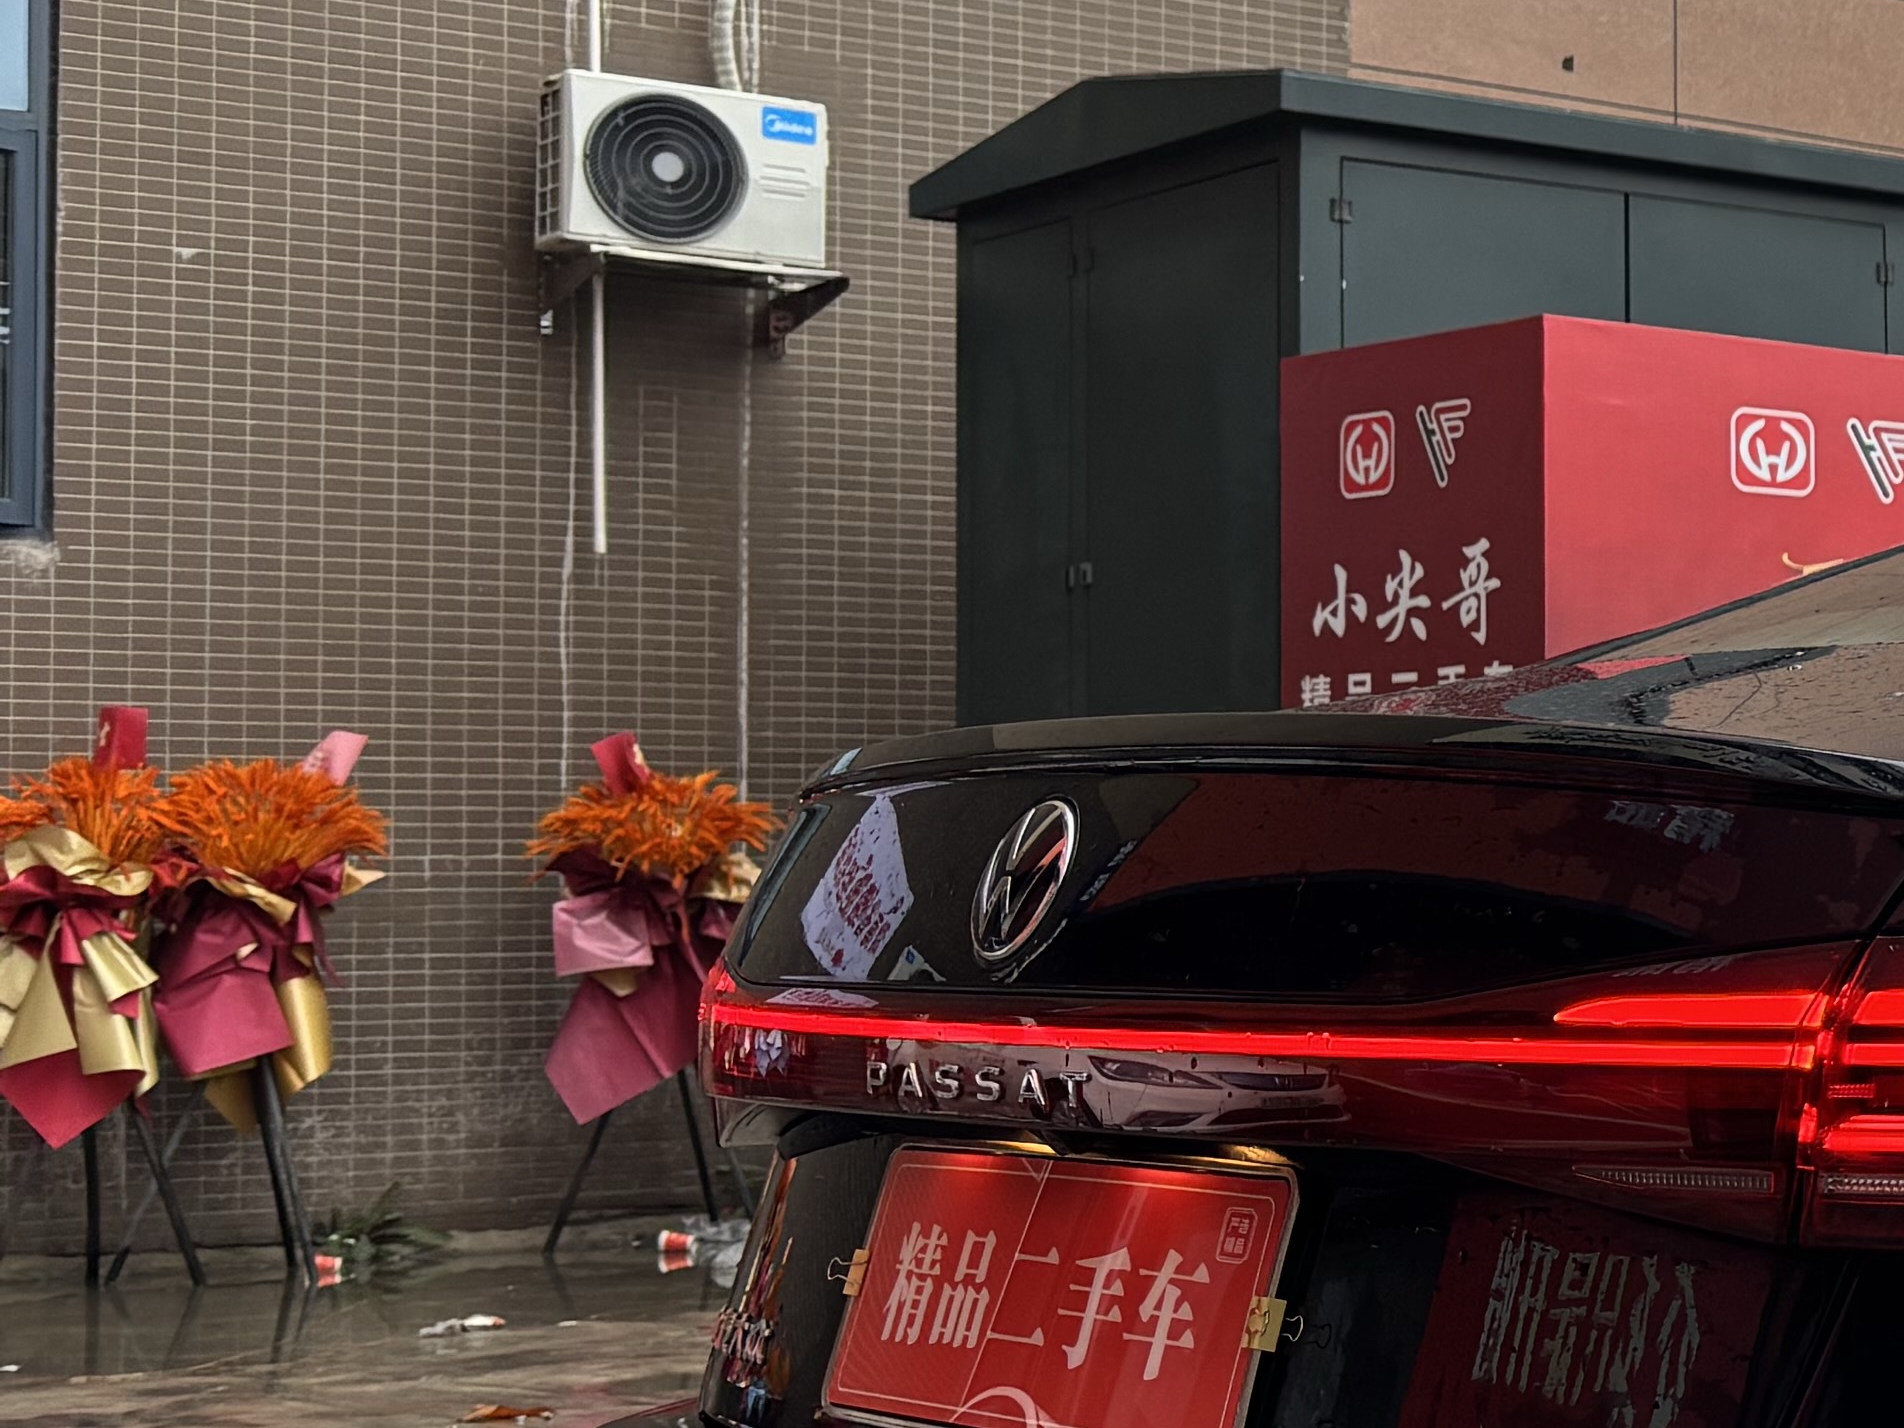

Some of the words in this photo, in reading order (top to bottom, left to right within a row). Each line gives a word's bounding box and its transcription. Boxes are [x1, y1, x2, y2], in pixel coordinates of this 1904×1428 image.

[1312, 536, 1502, 647] 小尖哥
[865, 1061, 1089, 1109] PASSAT
[880, 1220, 1211, 1382] 精品二手车
